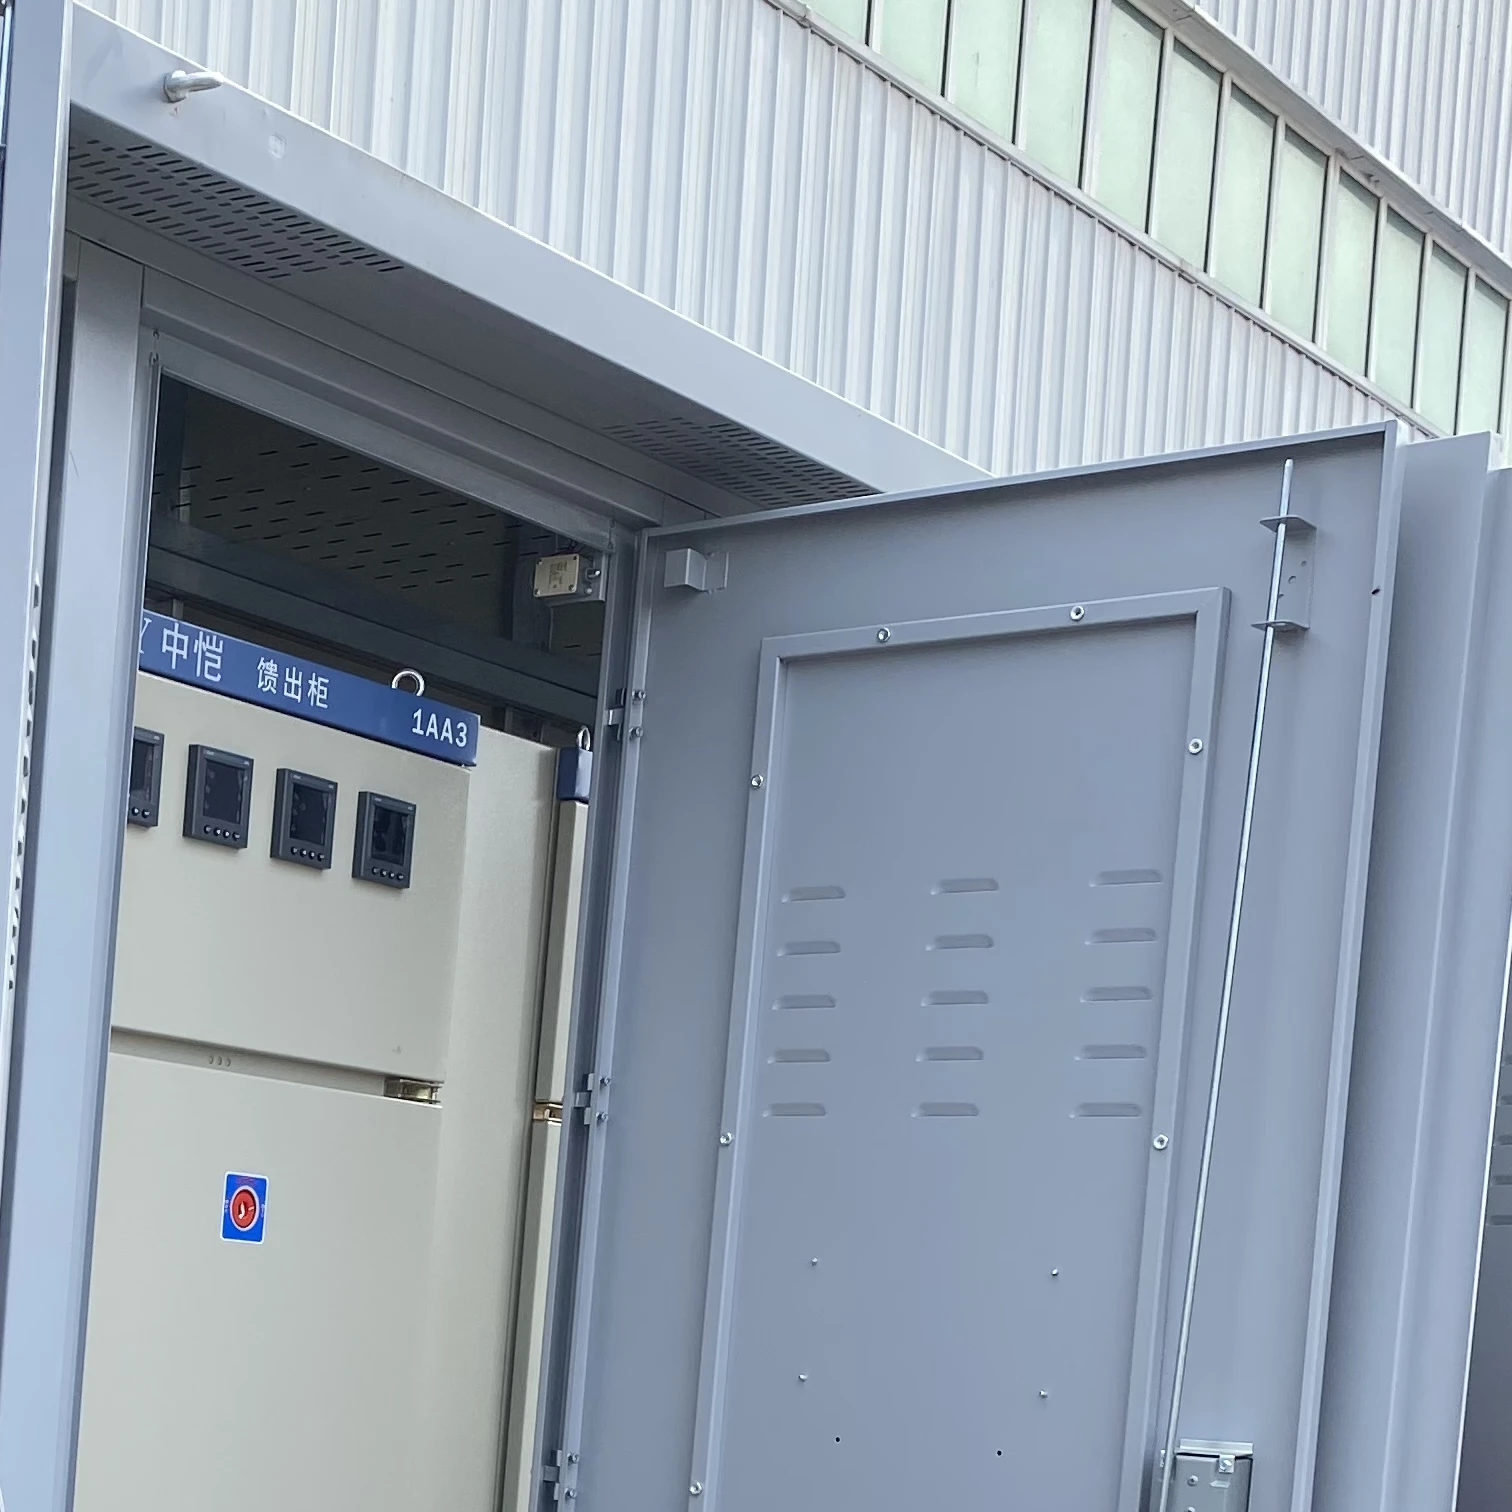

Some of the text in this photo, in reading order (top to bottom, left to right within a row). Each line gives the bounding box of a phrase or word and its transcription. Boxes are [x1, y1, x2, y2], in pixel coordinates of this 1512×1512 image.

[161, 622, 224, 683] 中恺
[256, 656, 330, 710] 馈出柜
[411, 708, 468, 748] 1AA3
